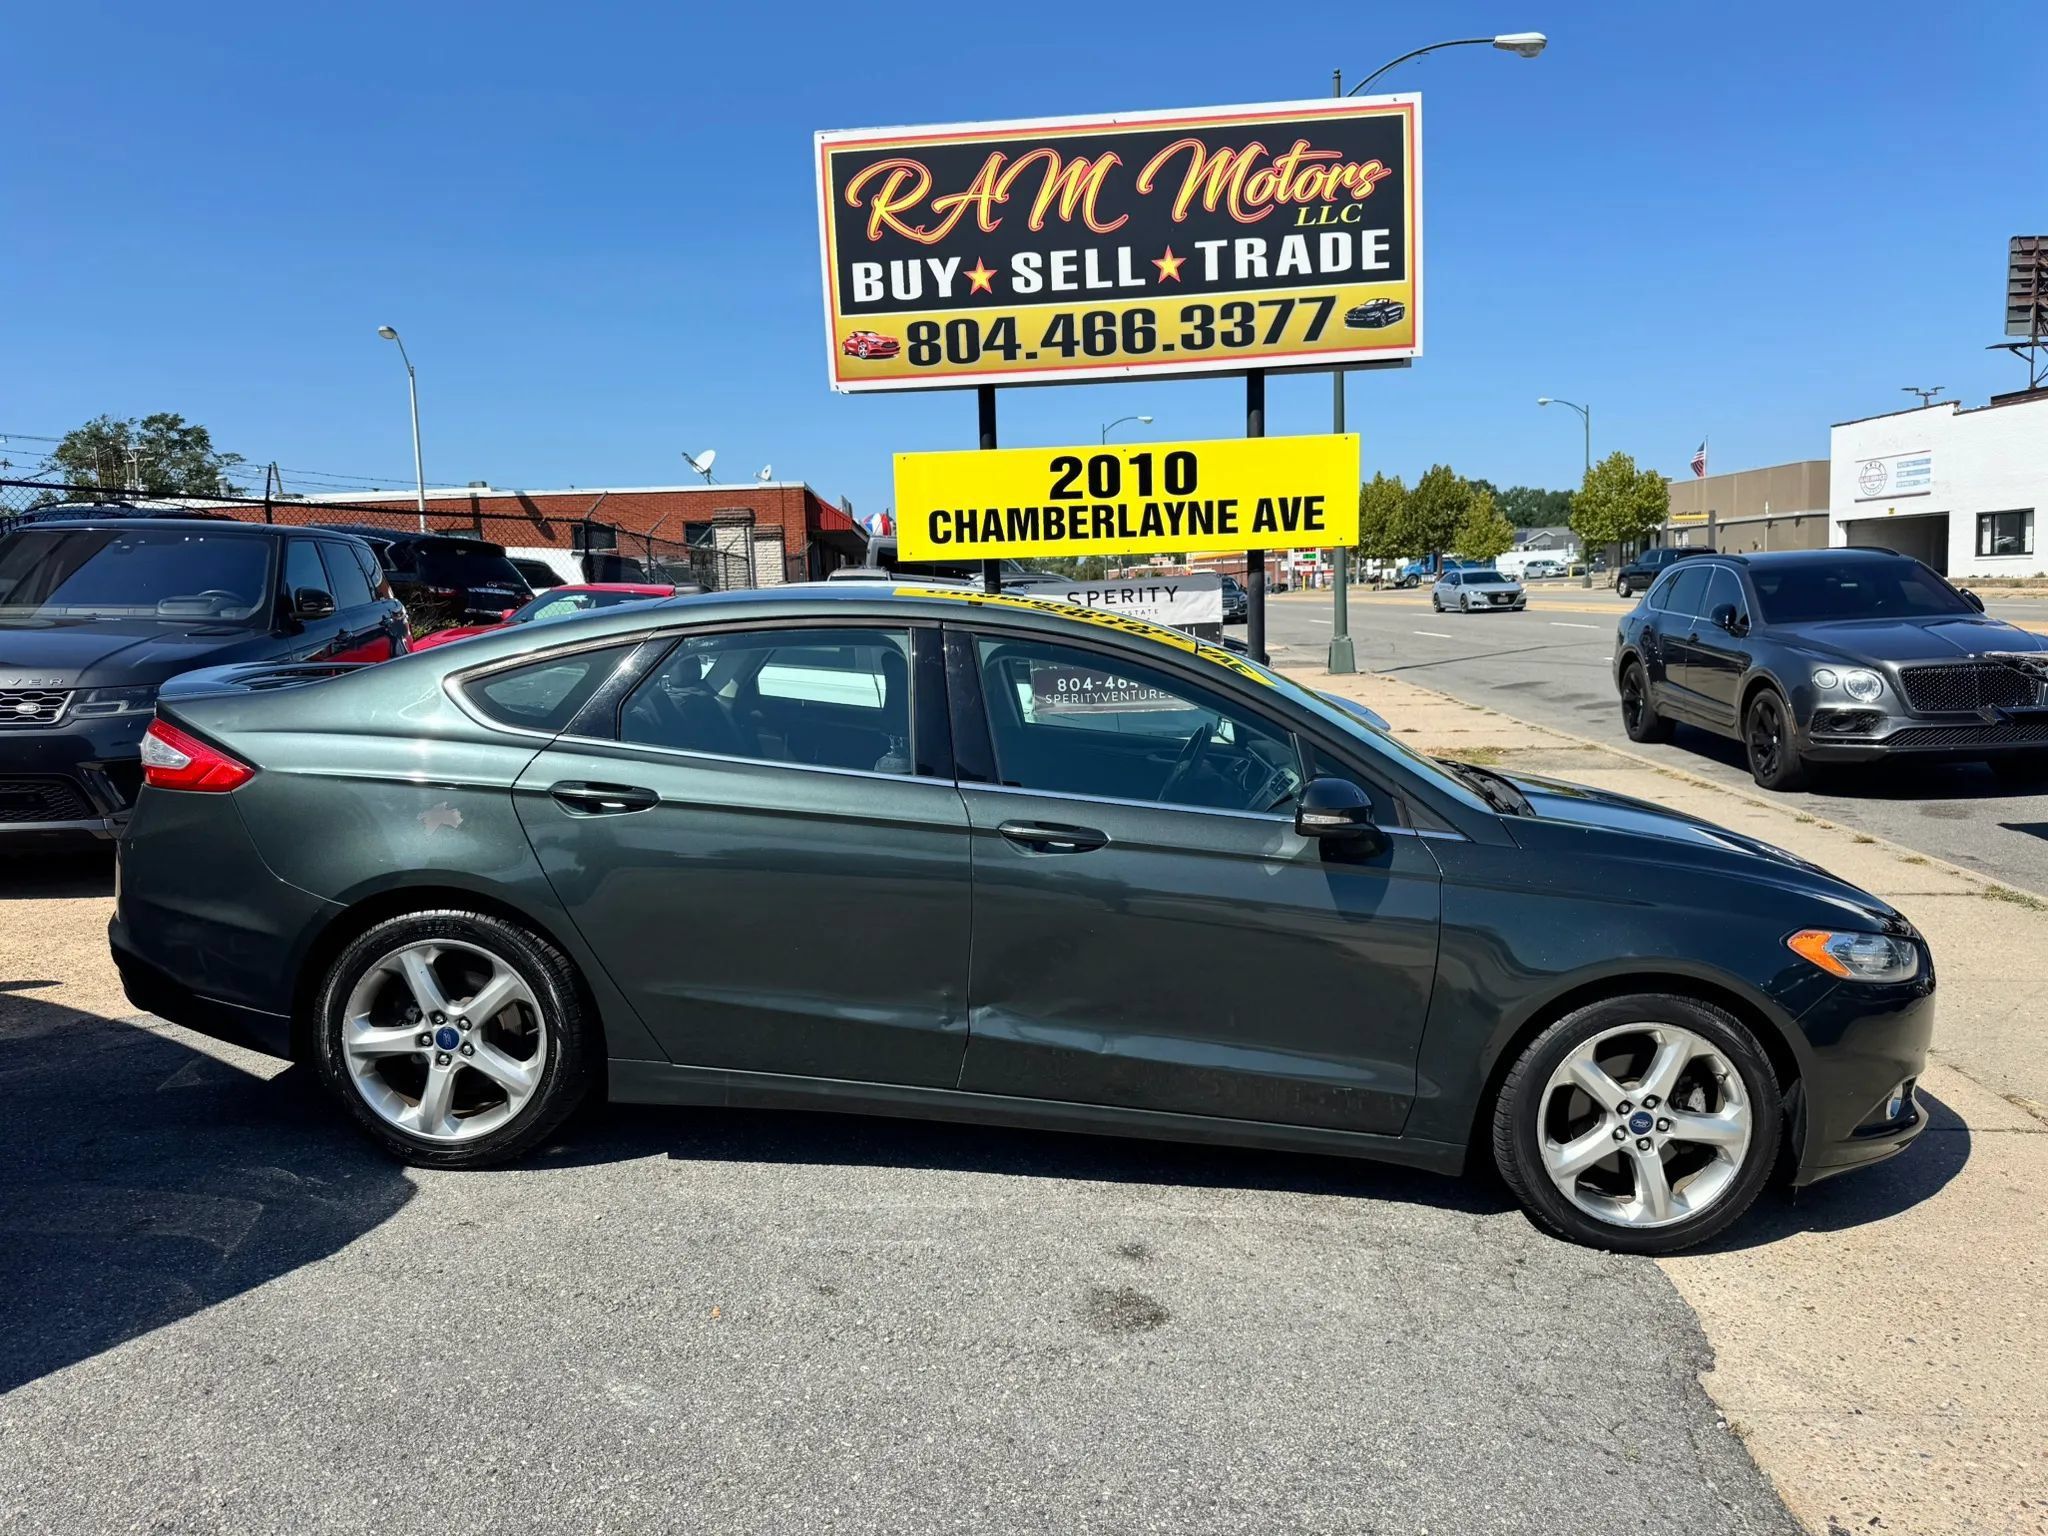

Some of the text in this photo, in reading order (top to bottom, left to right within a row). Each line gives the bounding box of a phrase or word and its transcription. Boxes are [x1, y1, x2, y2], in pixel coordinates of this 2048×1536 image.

[844, 138, 1392, 245] RAM Motors
[1293, 203, 1365, 227] LLC
[851, 228, 1391, 304] BUY SELL TRADE
[905, 294, 1338, 368] 804.466.3377
[1049, 450, 1199, 500] 2010
[927, 495, 1326, 545] CHAMBERLAYNE AVE
[1067, 585, 1179, 608] SPERITY
